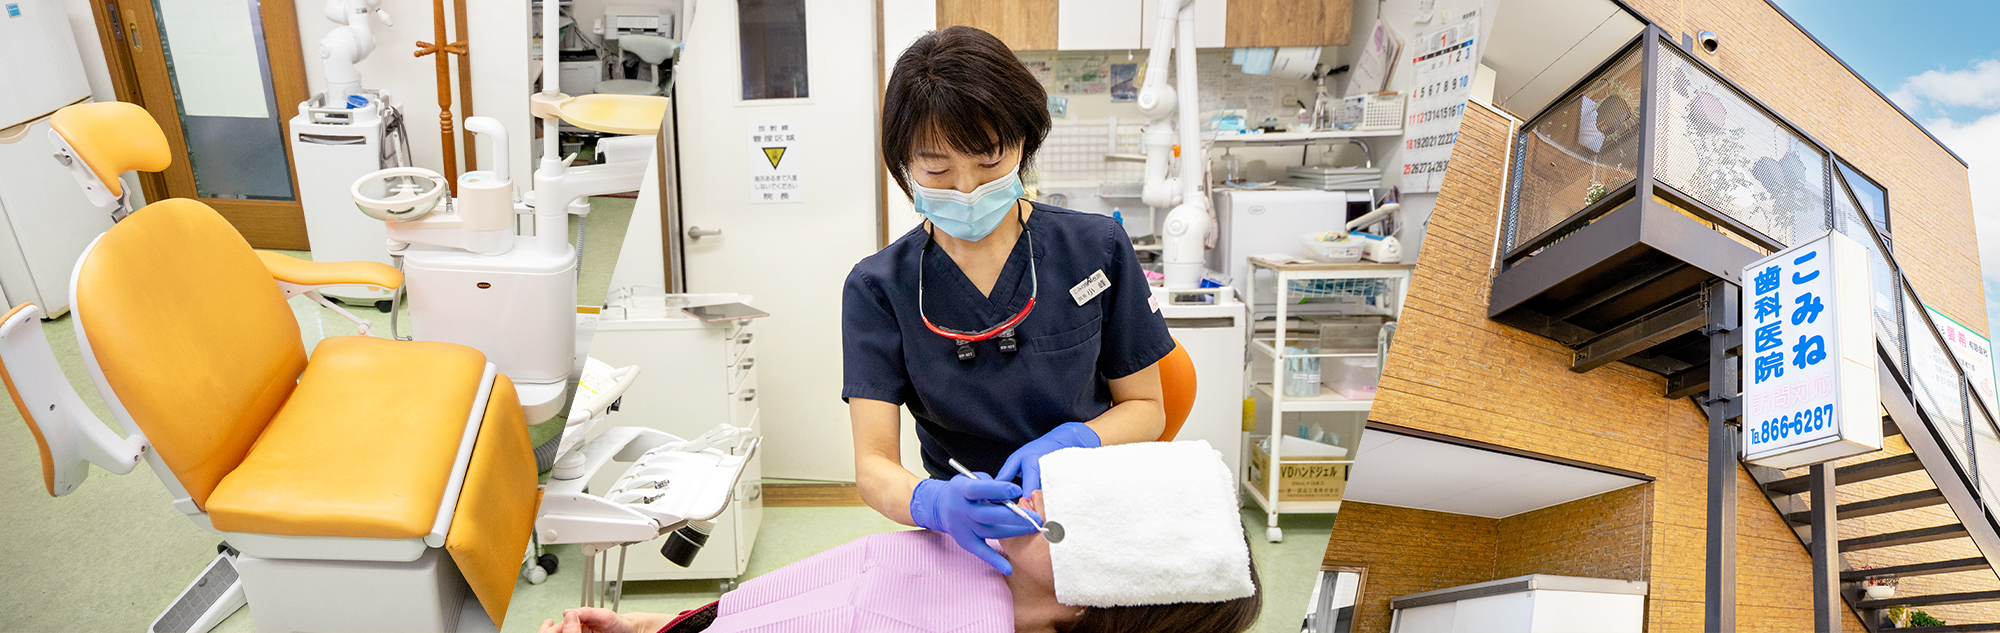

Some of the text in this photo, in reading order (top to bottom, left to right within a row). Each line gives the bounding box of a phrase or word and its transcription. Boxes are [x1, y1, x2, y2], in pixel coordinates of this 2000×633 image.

[1441, 34, 1446, 48] 1
[1449, 53, 1452, 64] 1
[1456, 50, 1461, 62] 2
[1465, 47, 1470, 60] 3
[1421, 87, 1425, 98] 5
[1428, 85, 1433, 96] 6
[1436, 82, 1441, 94] 7
[1444, 80, 1448, 92] 8
[1452, 78, 1457, 90] 9
[1460, 75, 1468, 88] 10
[1409, 114, 1416, 125] 11
[1417, 112, 1424, 124] 12
[1424, 110, 1432, 122] 13
[1440, 107, 1447, 119] 15
[1448, 105, 1456, 117] 16
[1457, 103, 1465, 115] 17
[753, 134, 796, 142] 管理区域
[1403, 163, 1411, 175] 25
[1791, 250, 1827, 370] こみね
[1753, 264, 1784, 385] 歯科医院
[1752, 372, 1832, 416] 訪問対応
[1761, 403, 1834, 444] 866-6287
[1280, 465, 1337, 478] VDハンドジェル
